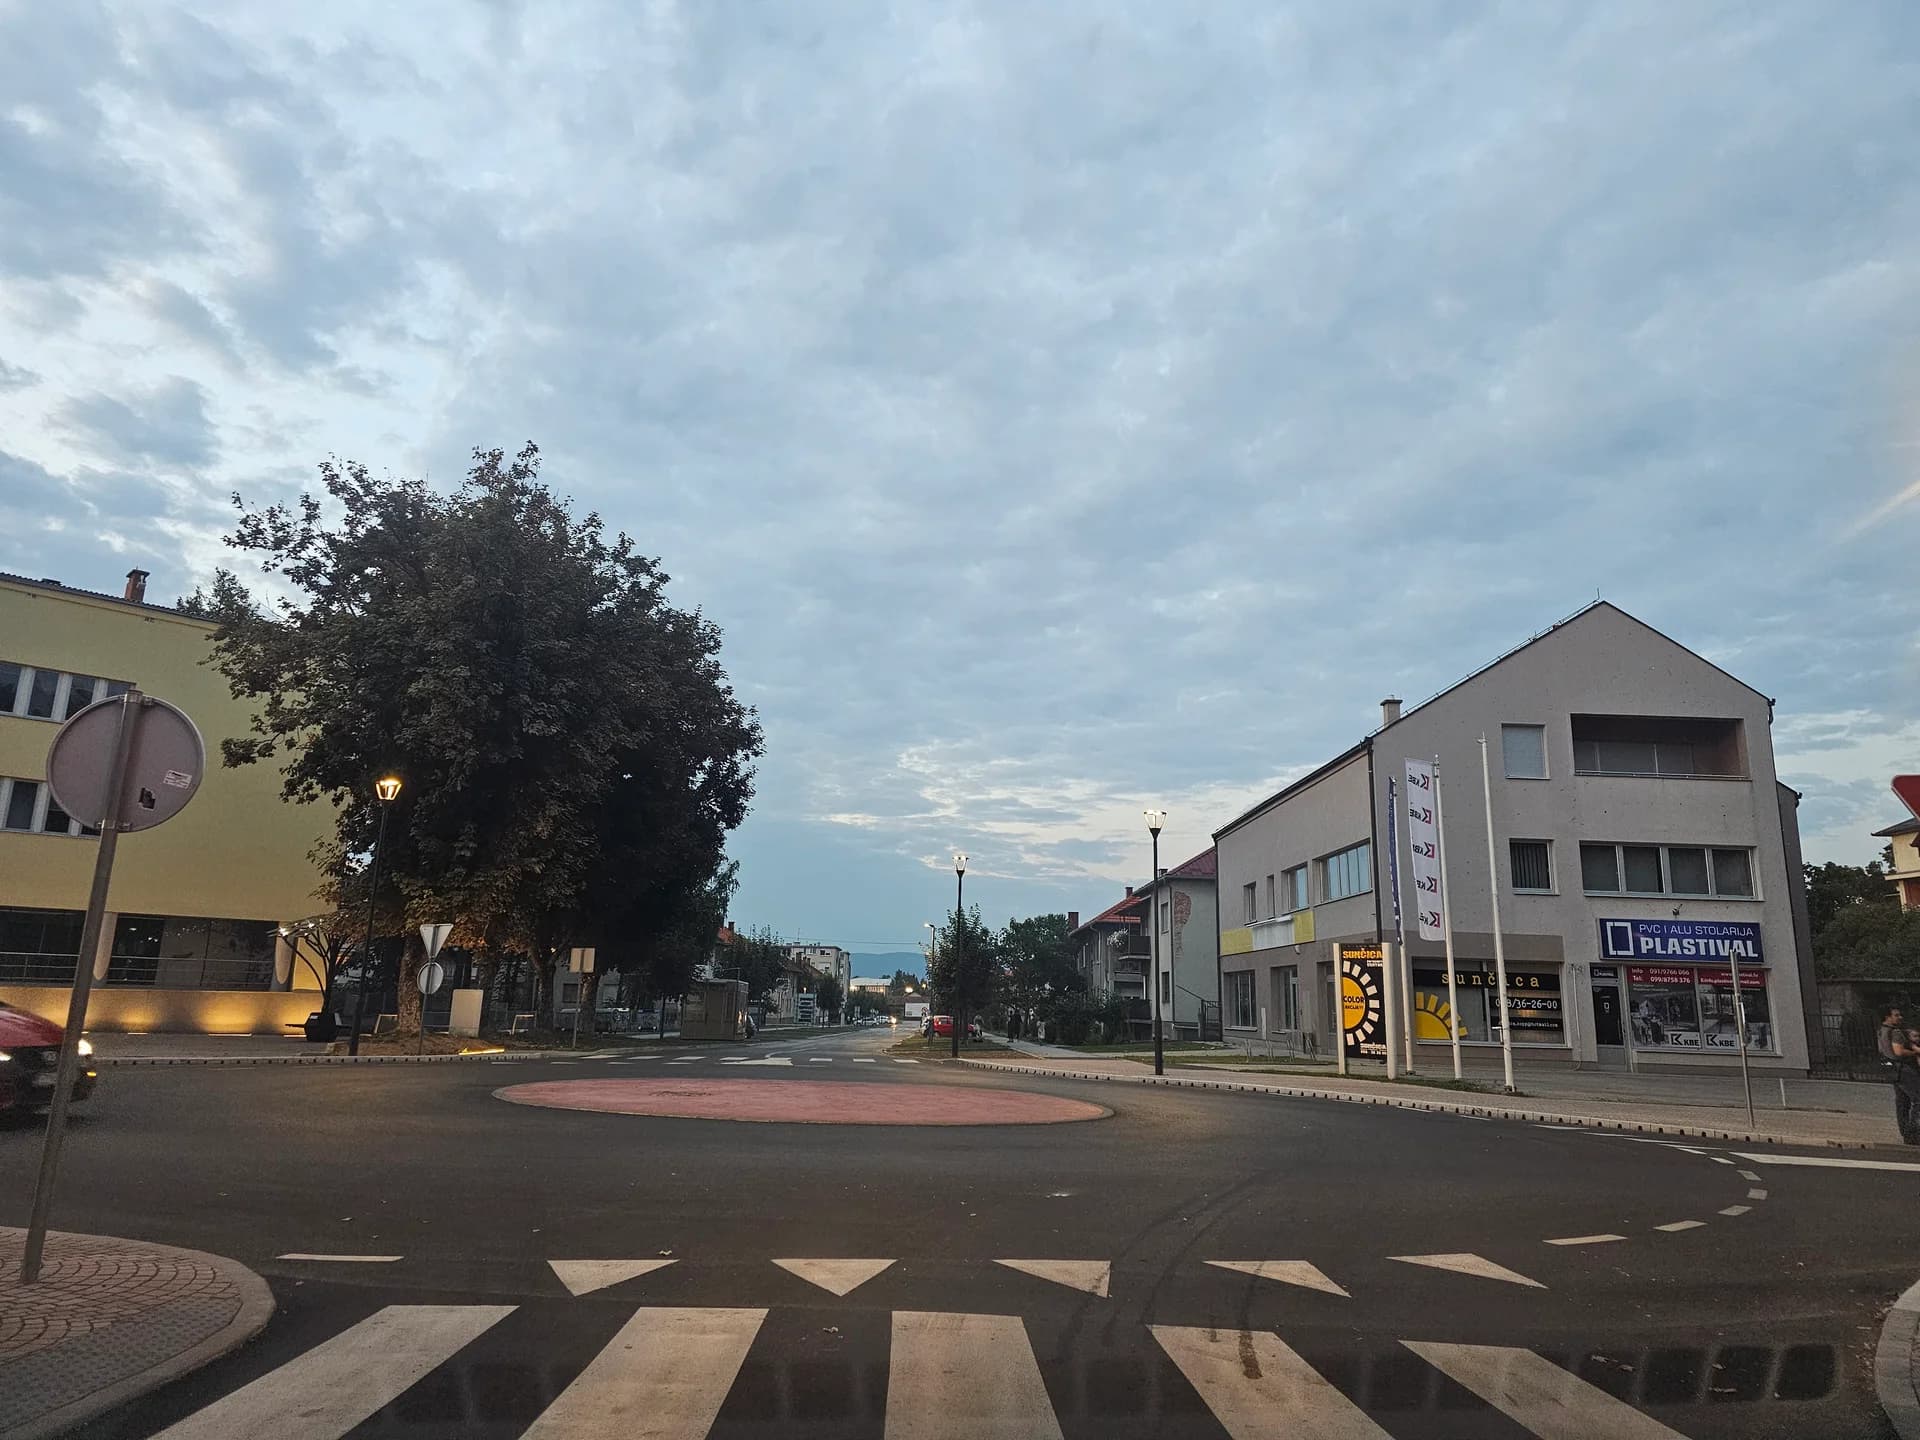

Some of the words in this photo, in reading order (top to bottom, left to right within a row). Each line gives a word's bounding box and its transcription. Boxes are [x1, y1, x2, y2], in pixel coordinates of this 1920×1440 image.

[1639, 924, 1661, 934] PVC
[1670, 925, 1692, 935] ALU
[1695, 925, 1754, 936] STOLARIJA
[1640, 937, 1759, 957] PLASTIVAL
[1441, 972, 1540, 987] sunčca
[1343, 995, 1365, 1004] COLOR
[1495, 998, 1558, 1009] 08/36-26-00
[1683, 1039, 1700, 1047] KBE
[1719, 1039, 1735, 1047] KBE
